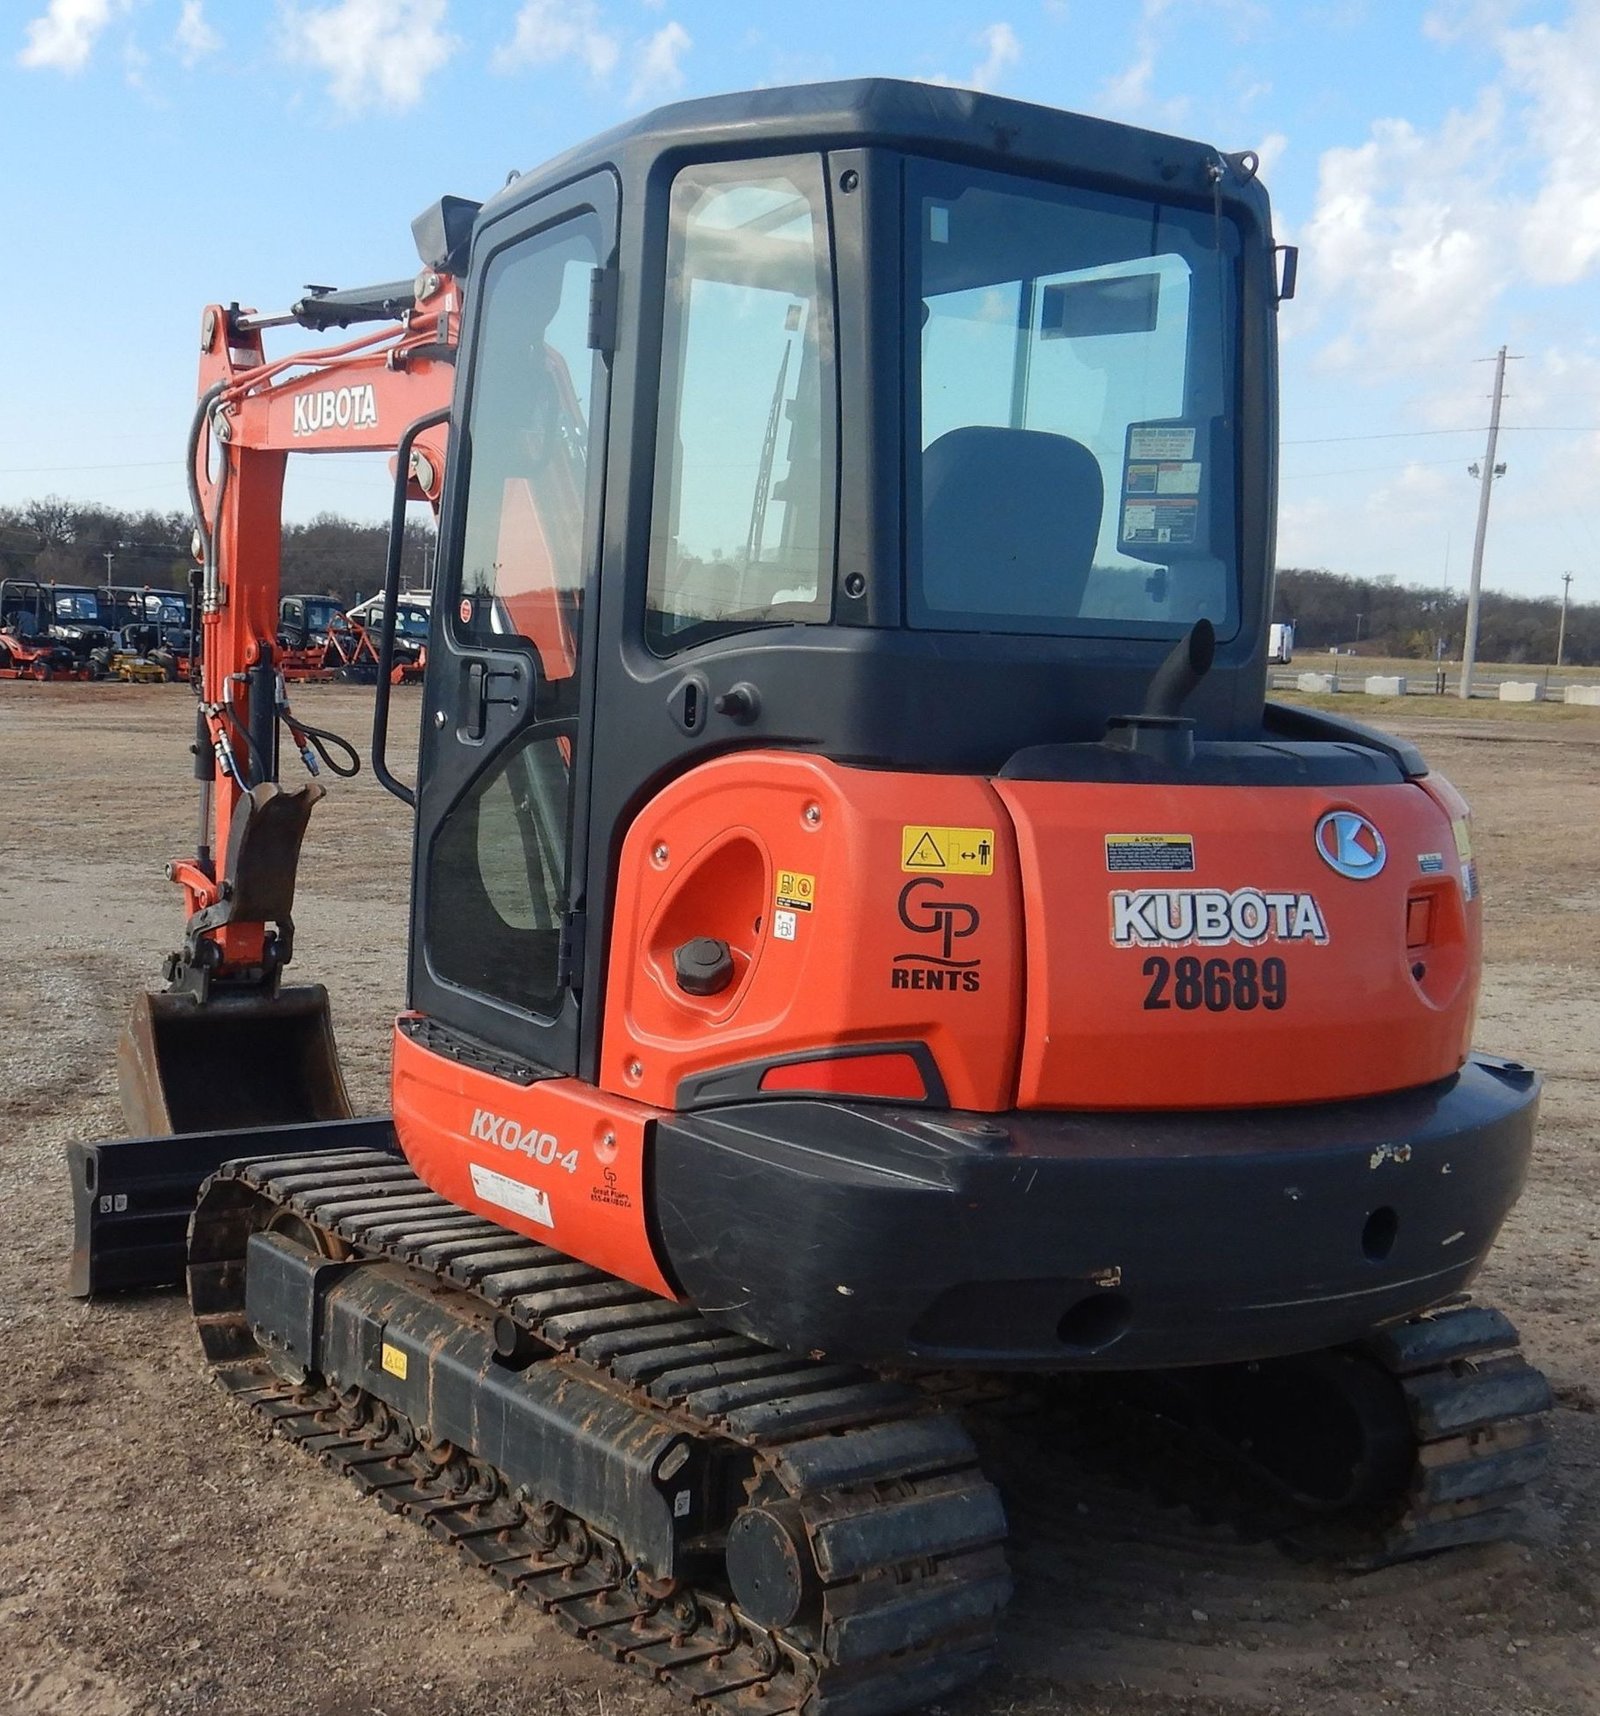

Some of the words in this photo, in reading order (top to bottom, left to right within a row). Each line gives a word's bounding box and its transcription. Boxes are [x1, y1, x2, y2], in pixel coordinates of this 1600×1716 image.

[292, 383, 378, 433] KUBOTA
[1112, 890, 1326, 943] KUBOTA
[891, 968, 981, 993] RENTS
[1142, 956, 1287, 1012] 28689
[469, 1108, 580, 1174] KX040-4
